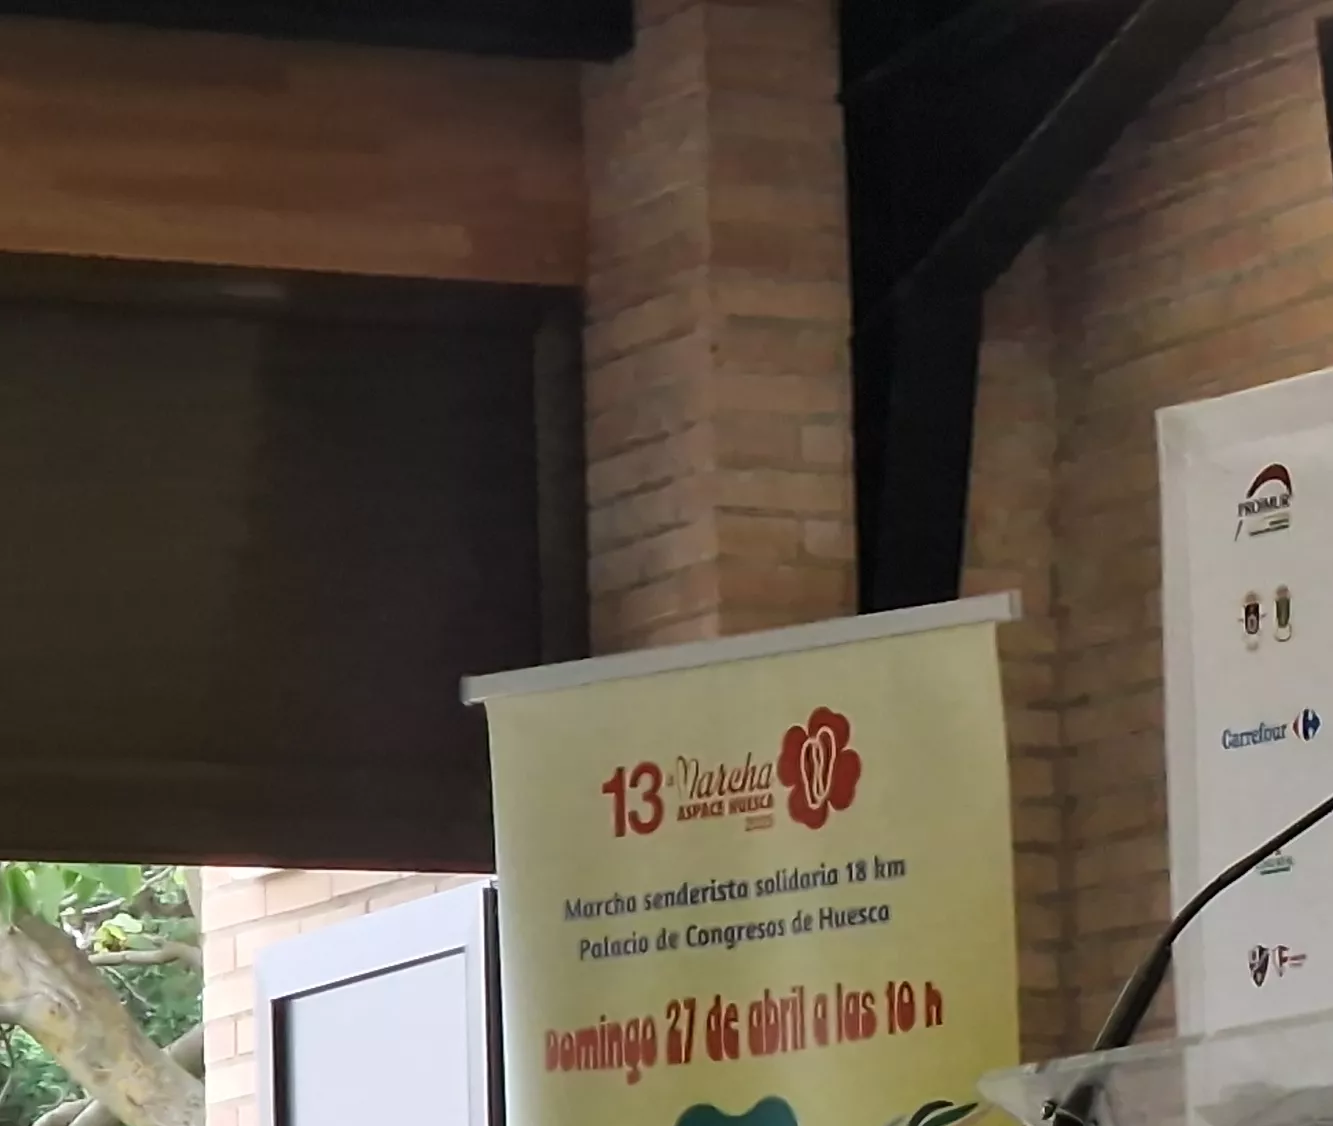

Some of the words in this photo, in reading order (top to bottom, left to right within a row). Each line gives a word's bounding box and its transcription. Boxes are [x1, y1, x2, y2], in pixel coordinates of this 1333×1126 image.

[1222, 722, 1288, 750] Carrefour
[675, 751, 774, 801] Marcha
[563, 892, 637, 921] Marcha
[643, 879, 748, 913] senderista
[755, 863, 839, 896] solidaria
[845, 859, 868, 884] 18
[873, 855, 907, 881] km
[578, 931, 649, 961] Palacio
[655, 926, 680, 951] de
[686, 916, 786, 950] Congresos
[792, 910, 814, 935] de
[818, 903, 891, 932] Huesca
[544, 1011, 658, 1086] Domingo
[664, 996, 698, 1067] 27
[705, 992, 742, 1063] de
[747, 983, 807, 1056] abril
[812, 988, 831, 1048] a
[836, 981, 879, 1046] las
[883, 979, 918, 1037] 10
[923, 978, 945, 1029] h
